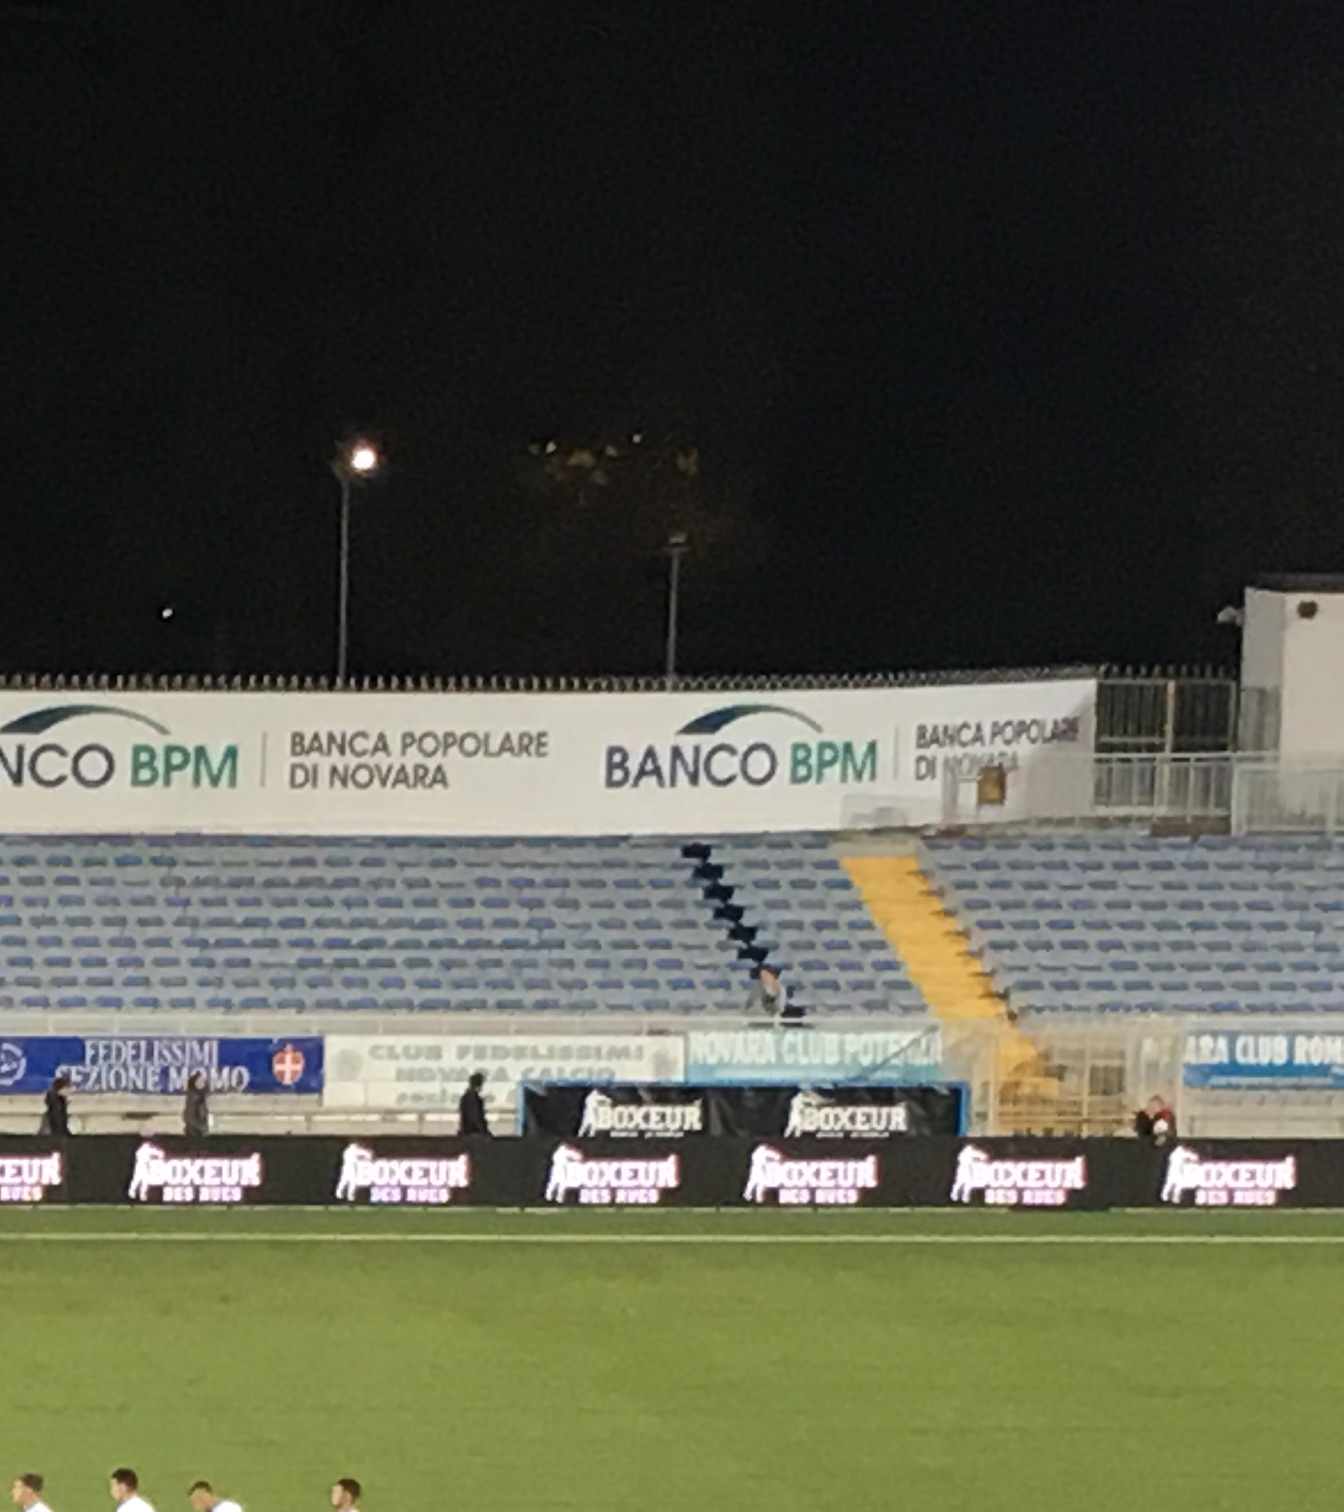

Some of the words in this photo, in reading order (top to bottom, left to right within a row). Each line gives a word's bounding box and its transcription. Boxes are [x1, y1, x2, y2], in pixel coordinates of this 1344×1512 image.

[289, 731, 391, 758] BANCA
[399, 730, 549, 760] POPOLARE
[916, 721, 986, 749] BANCA
[989, 716, 1080, 745] POPOLARE
[130, 743, 239, 789] BPM
[289, 764, 319, 790] DI
[329, 764, 449, 790] NOVARA
[604, 743, 777, 789] BANCO
[788, 740, 877, 785] BPM
[915, 754, 937, 781] DI
[84, 1039, 219, 1066] FEDELISSIMI
[368, 1044, 443, 1061] CLUB
[688, 1030, 776, 1066] NOVARA
[781, 1030, 841, 1066] CLUB
[1235, 1035, 1289, 1066] CLUB
[595, 1101, 703, 1131] BOXEUR
[801, 1104, 908, 1132] BOXEUR
[153, 1155, 263, 1186] BOXEUR
[359, 1155, 470, 1188] BOXEUR
[564, 1156, 680, 1188] BOXEUR
[768, 1157, 878, 1188] BOXEUR
[978, 1157, 1086, 1189] BOXEUR
[1188, 1158, 1297, 1190] BOXEUR
